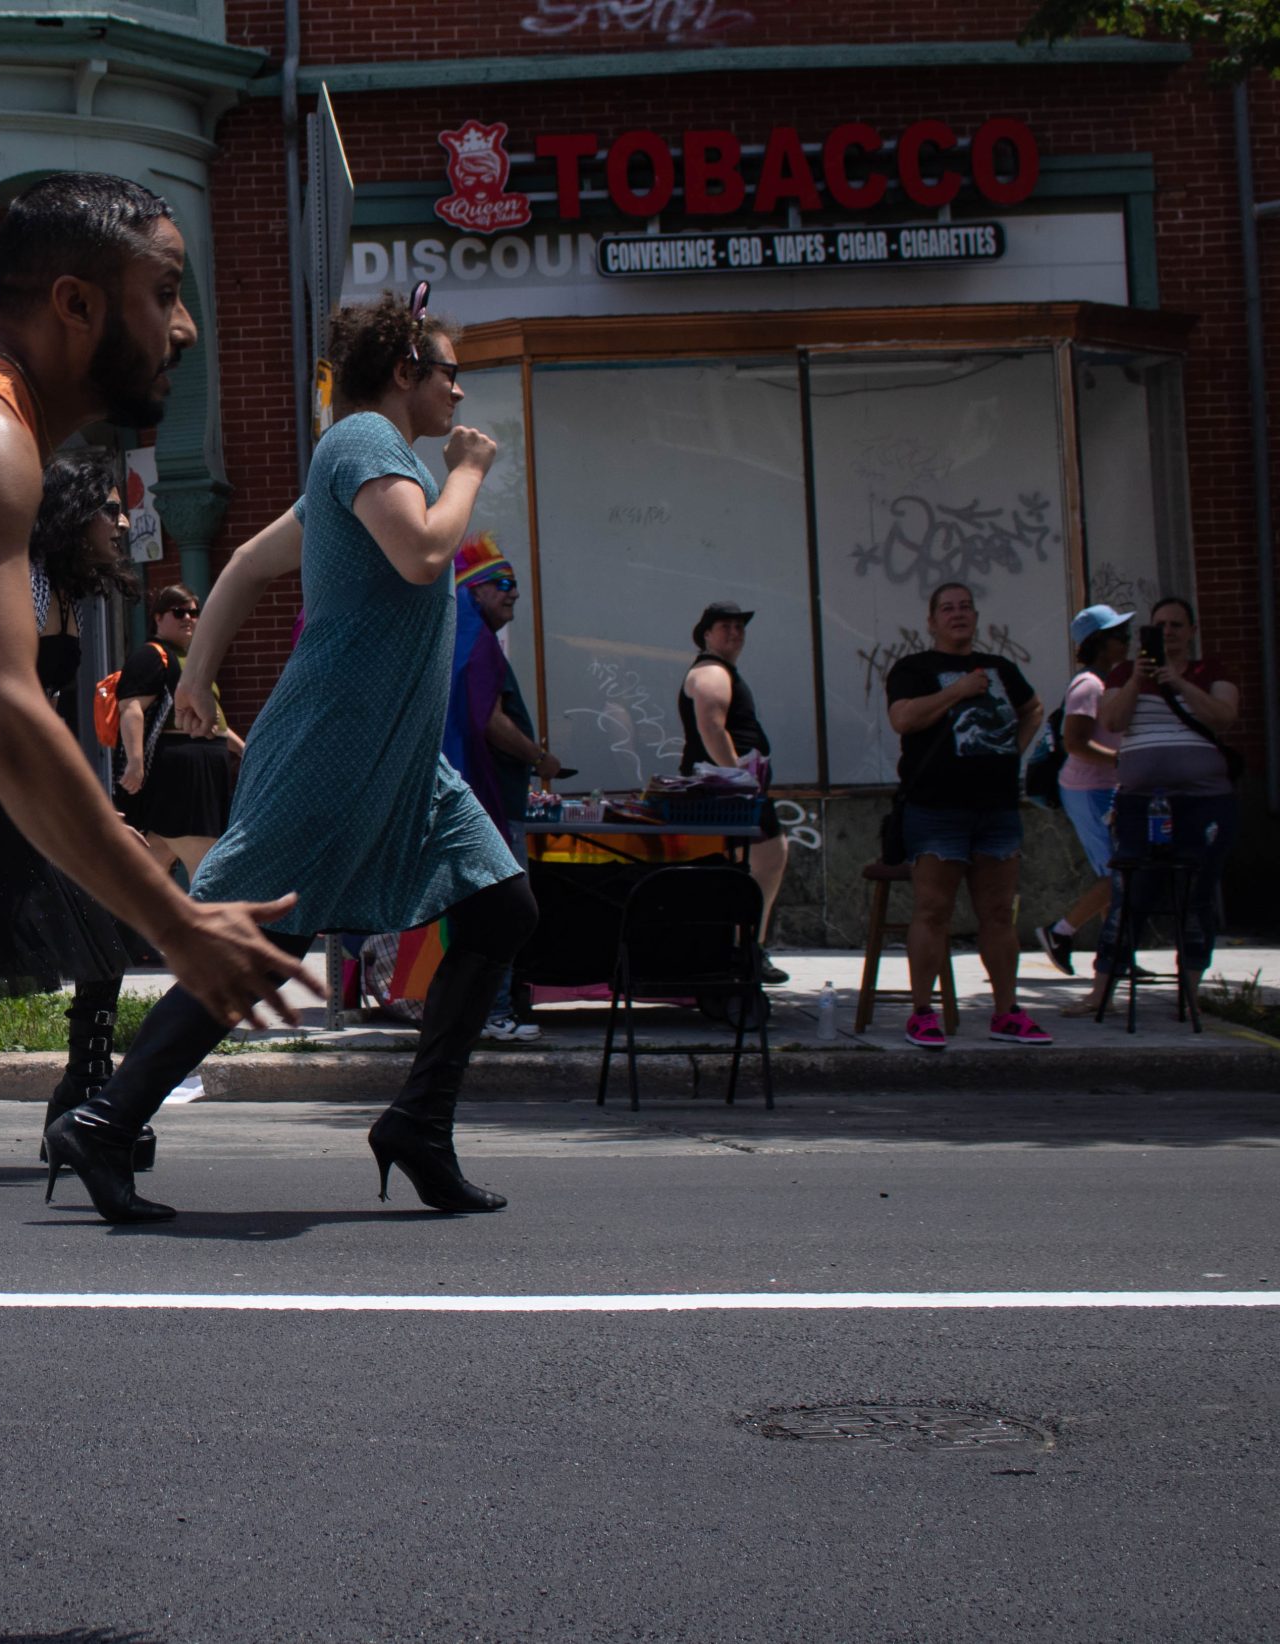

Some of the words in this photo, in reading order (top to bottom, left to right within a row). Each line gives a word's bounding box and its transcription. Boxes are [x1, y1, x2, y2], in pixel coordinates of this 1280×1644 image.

[535, 118, 1040, 220] TOBACCO
[442, 198, 521, 224] Queen
[352, 233, 598, 285] DISCOUN
[606, 238, 717, 272] CONVENIENCE
[728, 236, 763, 267] CBD
[773, 233, 826, 264] VAPES
[837, 230, 889, 262] CIGAR
[899, 226, 997, 258] CIGARETTES
